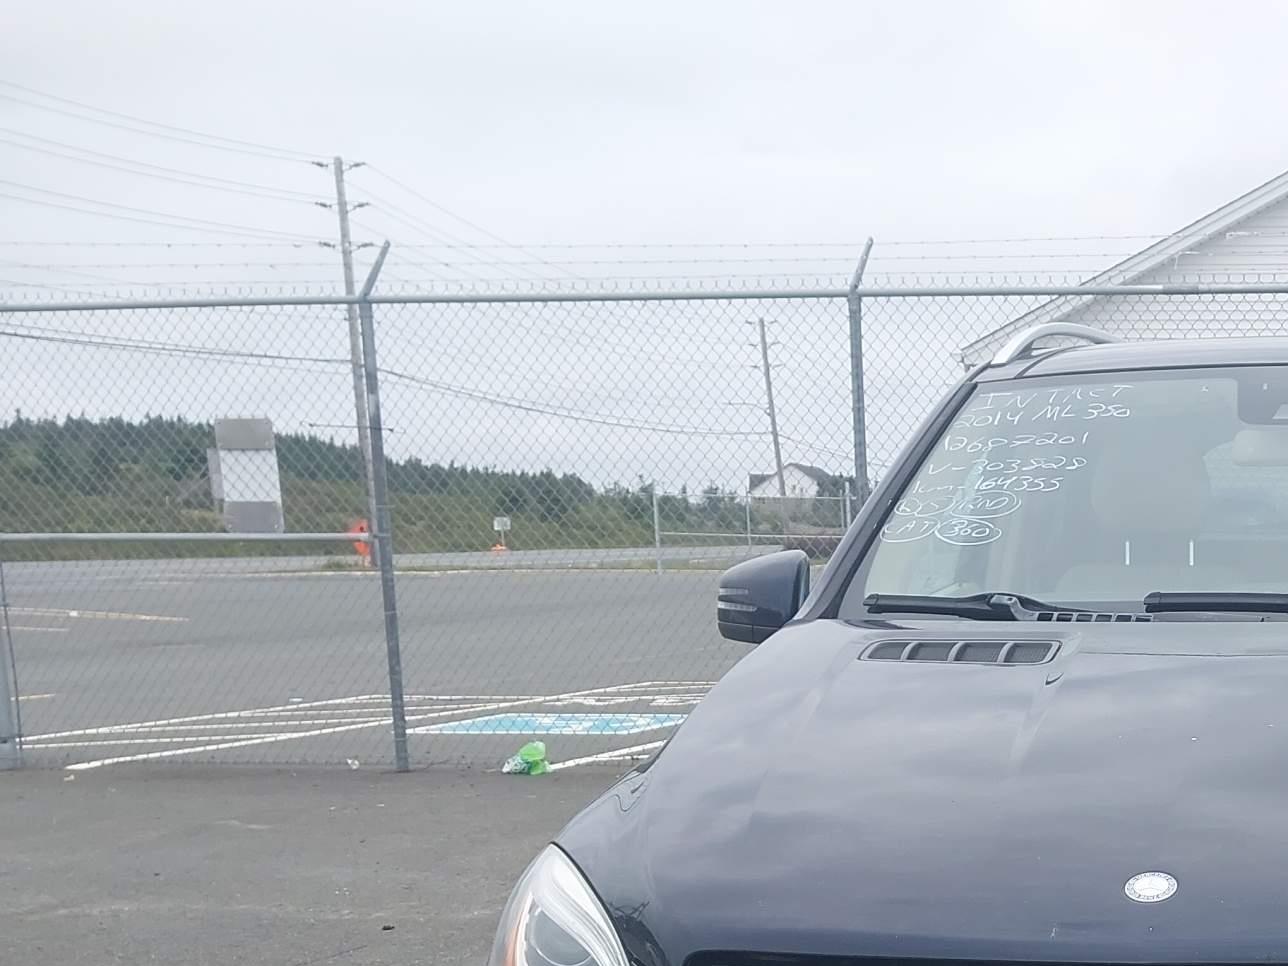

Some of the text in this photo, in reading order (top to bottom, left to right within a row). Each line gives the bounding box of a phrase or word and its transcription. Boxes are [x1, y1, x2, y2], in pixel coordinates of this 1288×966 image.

[953, 403, 1131, 428] 2014 ML 350
[944, 431, 1089, 453] 12687201
